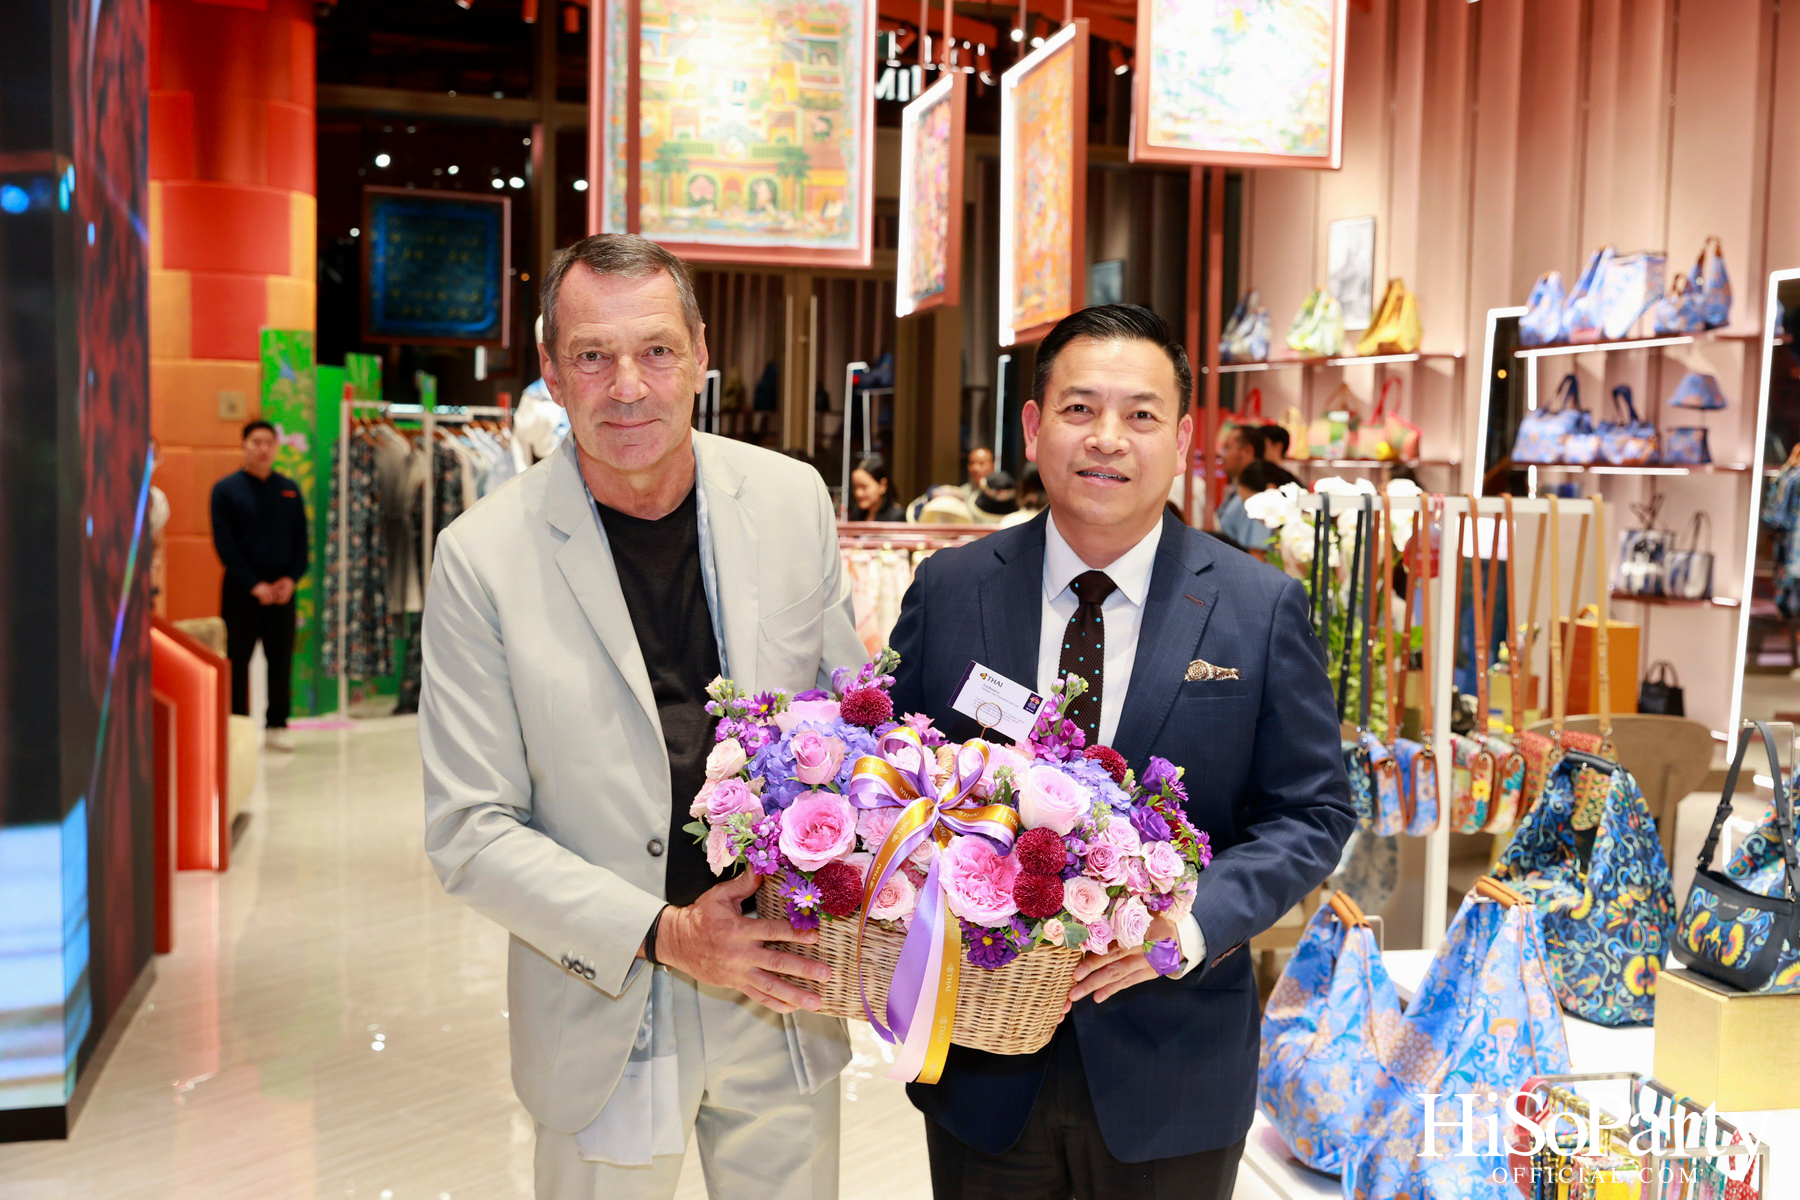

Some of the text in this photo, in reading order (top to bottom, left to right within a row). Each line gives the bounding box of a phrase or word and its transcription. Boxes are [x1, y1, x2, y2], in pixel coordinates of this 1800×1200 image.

[987, 675, 1004, 688] THAI
[895, 818, 912, 834] THAI
[871, 862, 882, 879] THAI
[945, 974, 954, 992] THAI
[936, 1025, 947, 1042] THAI
